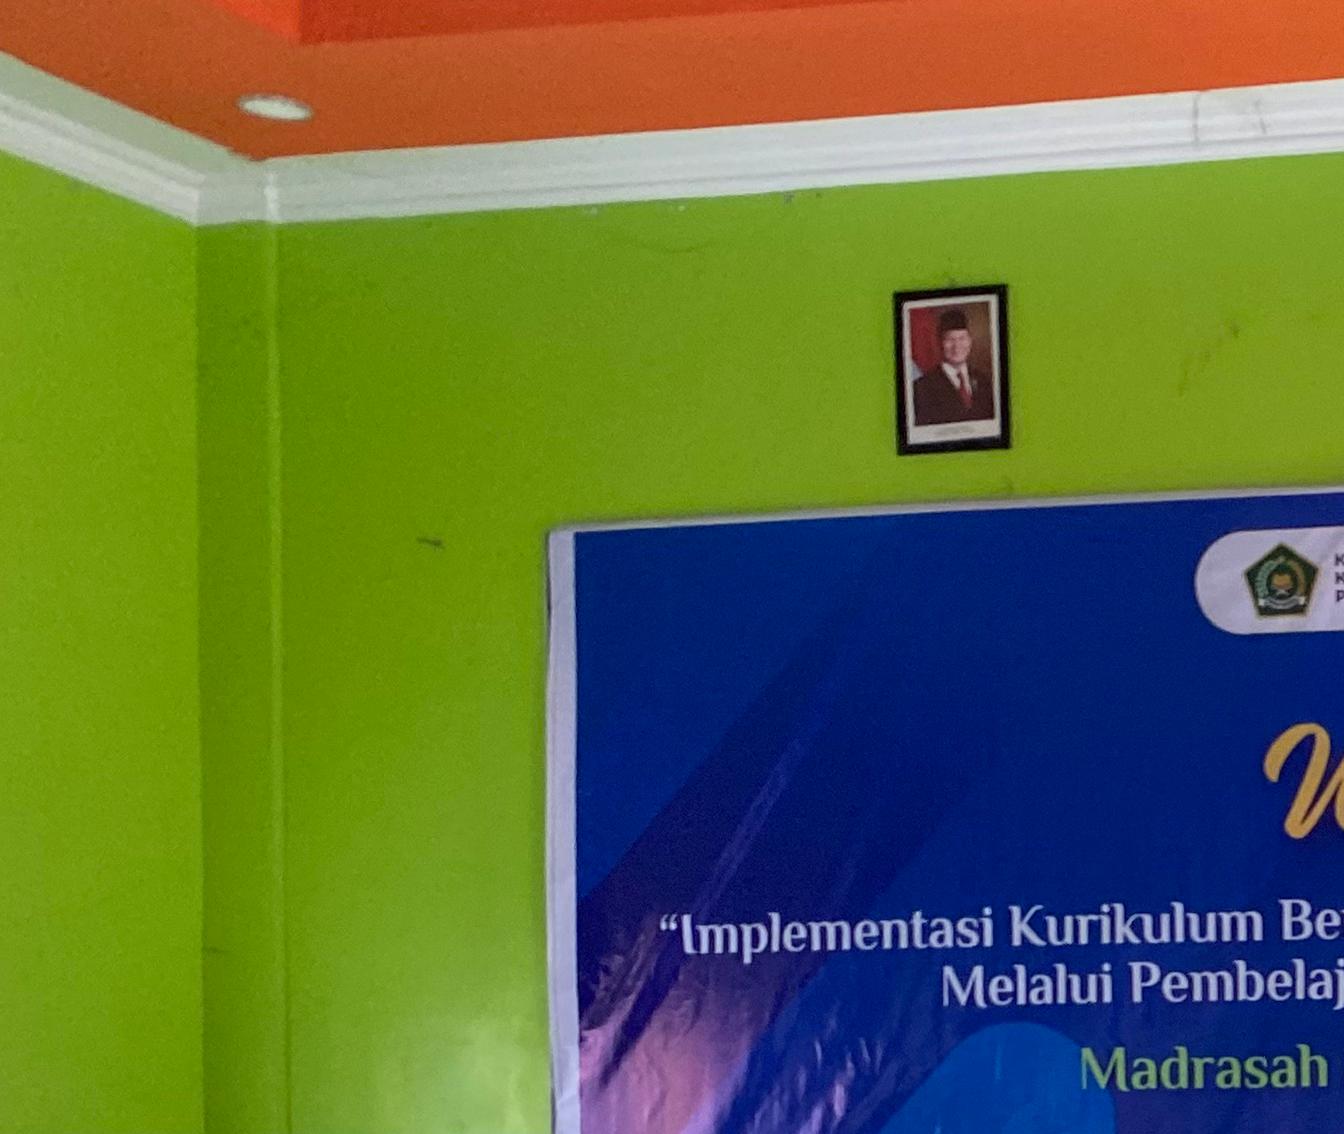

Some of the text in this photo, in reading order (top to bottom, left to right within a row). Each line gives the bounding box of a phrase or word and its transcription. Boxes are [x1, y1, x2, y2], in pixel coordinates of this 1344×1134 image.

[1007, 901, 1264, 947] Kurikulum
[941, 962, 1113, 1009] Melalui
[1079, 1043, 1329, 1092] Madrasah
